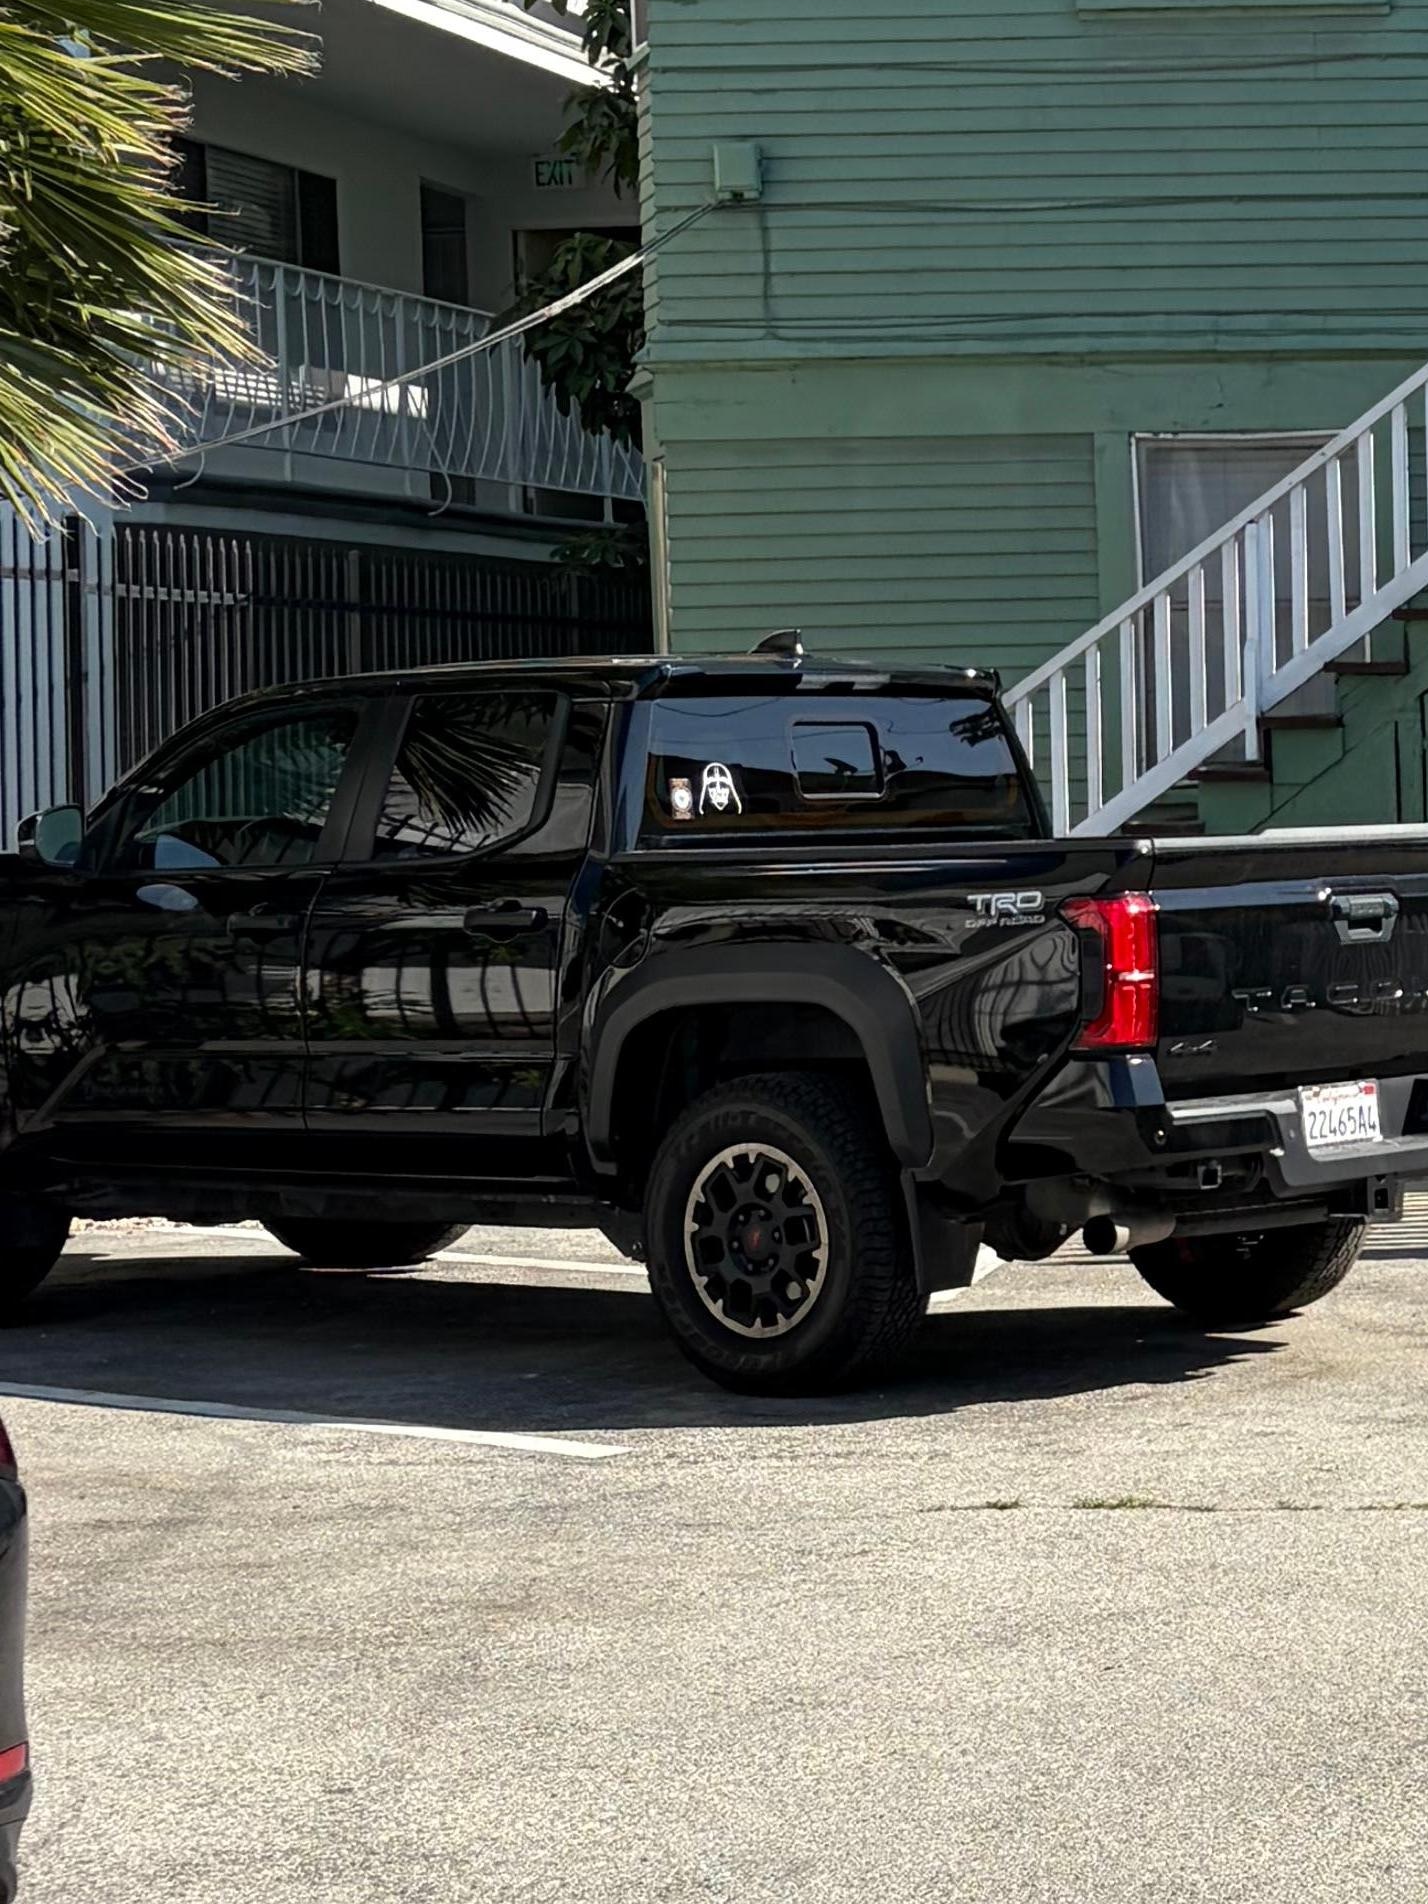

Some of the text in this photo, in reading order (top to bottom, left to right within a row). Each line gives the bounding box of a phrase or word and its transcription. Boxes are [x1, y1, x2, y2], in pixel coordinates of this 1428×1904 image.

[535, 160, 575, 186] EXIT
[967, 890, 1043, 916] TRD
[1307, 1104, 1377, 1140] 22465A4
